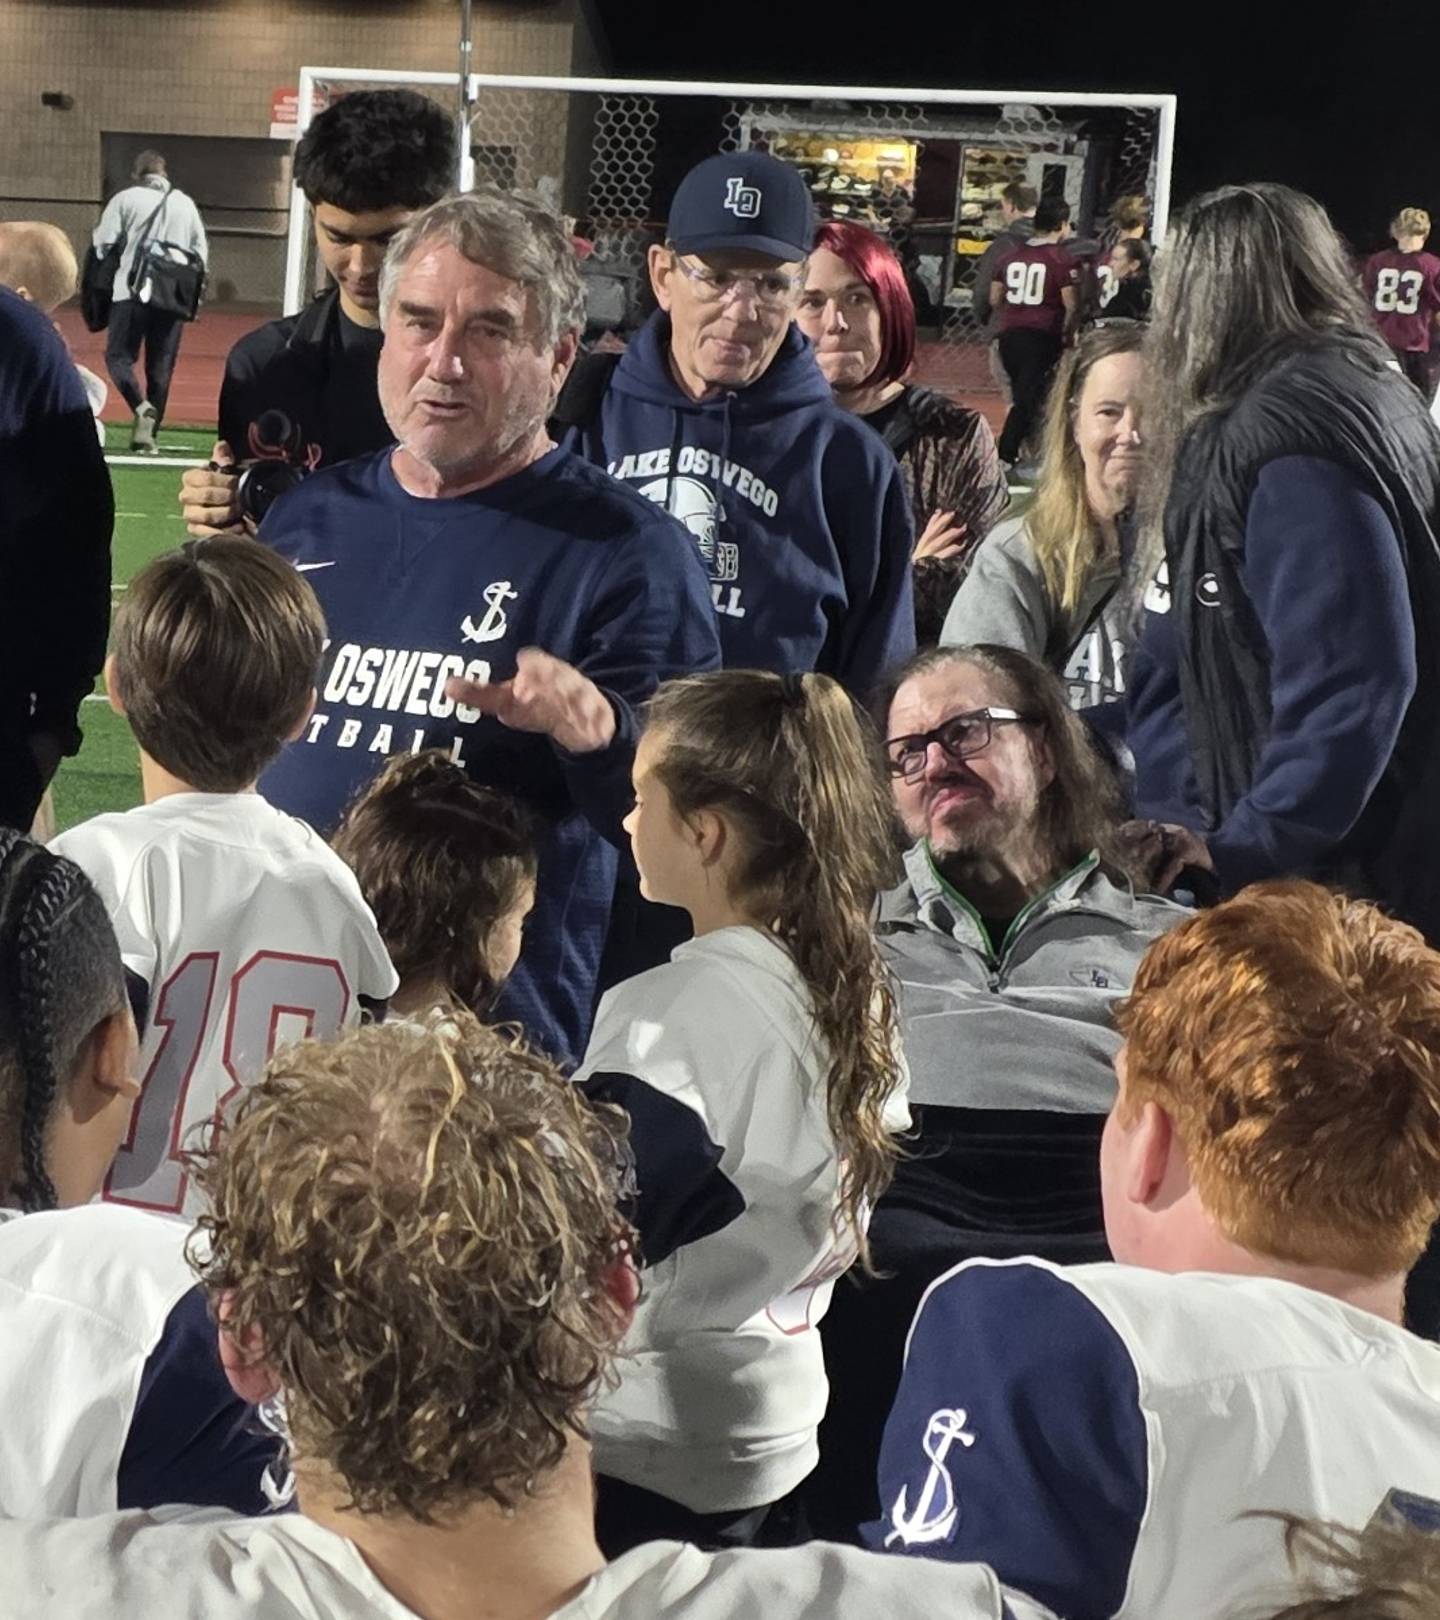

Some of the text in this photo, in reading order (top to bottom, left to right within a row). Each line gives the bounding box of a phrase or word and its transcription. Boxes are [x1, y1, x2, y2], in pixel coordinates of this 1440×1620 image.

[724, 176, 762, 218] LO
[1006, 262, 1047, 305] 90
[1375, 268, 1424, 315] 83
[677, 446, 779, 518] OSWEGO
[306, 713, 466, 769] TBALL
